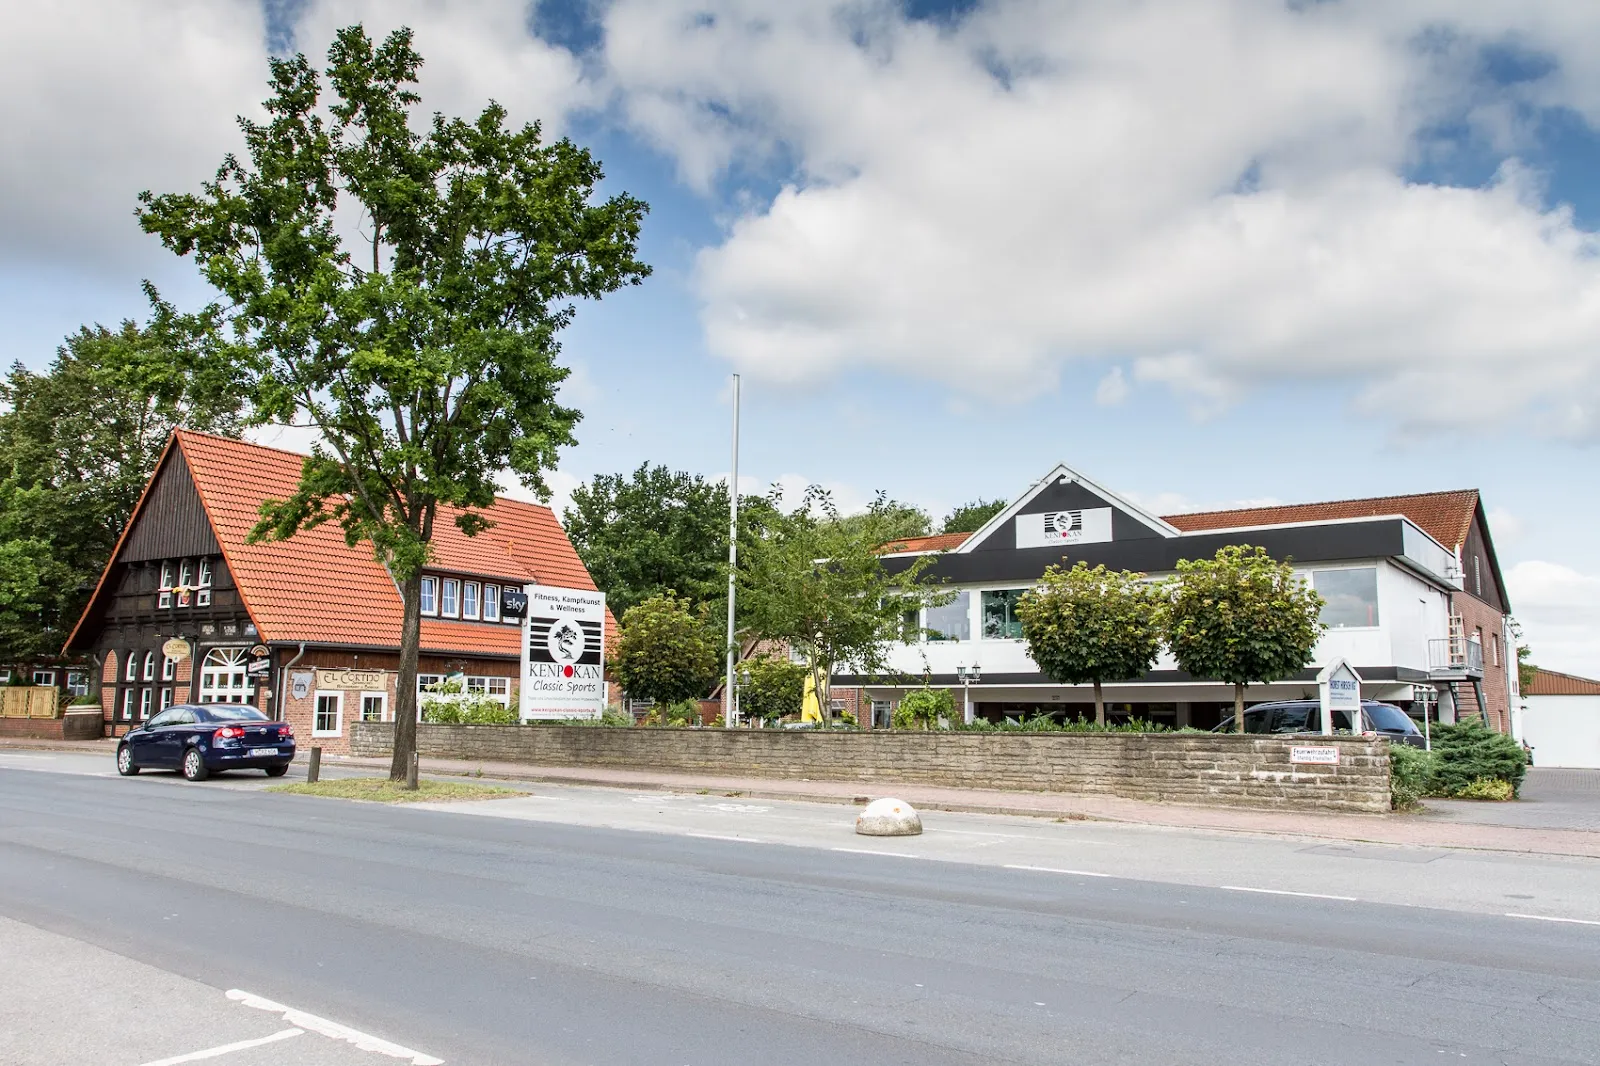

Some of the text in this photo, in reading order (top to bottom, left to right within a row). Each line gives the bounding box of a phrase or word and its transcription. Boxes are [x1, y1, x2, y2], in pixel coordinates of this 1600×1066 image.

[506, 598, 525, 612] sky
[534, 593, 601, 605] Fitness, Kampfkunst
[556, 605, 585, 613] Wellness
[324, 672, 380, 684] EL CORTIJO
[529, 664, 600, 679] KENPOKAN
[533, 680, 596, 694] Classic Sports
